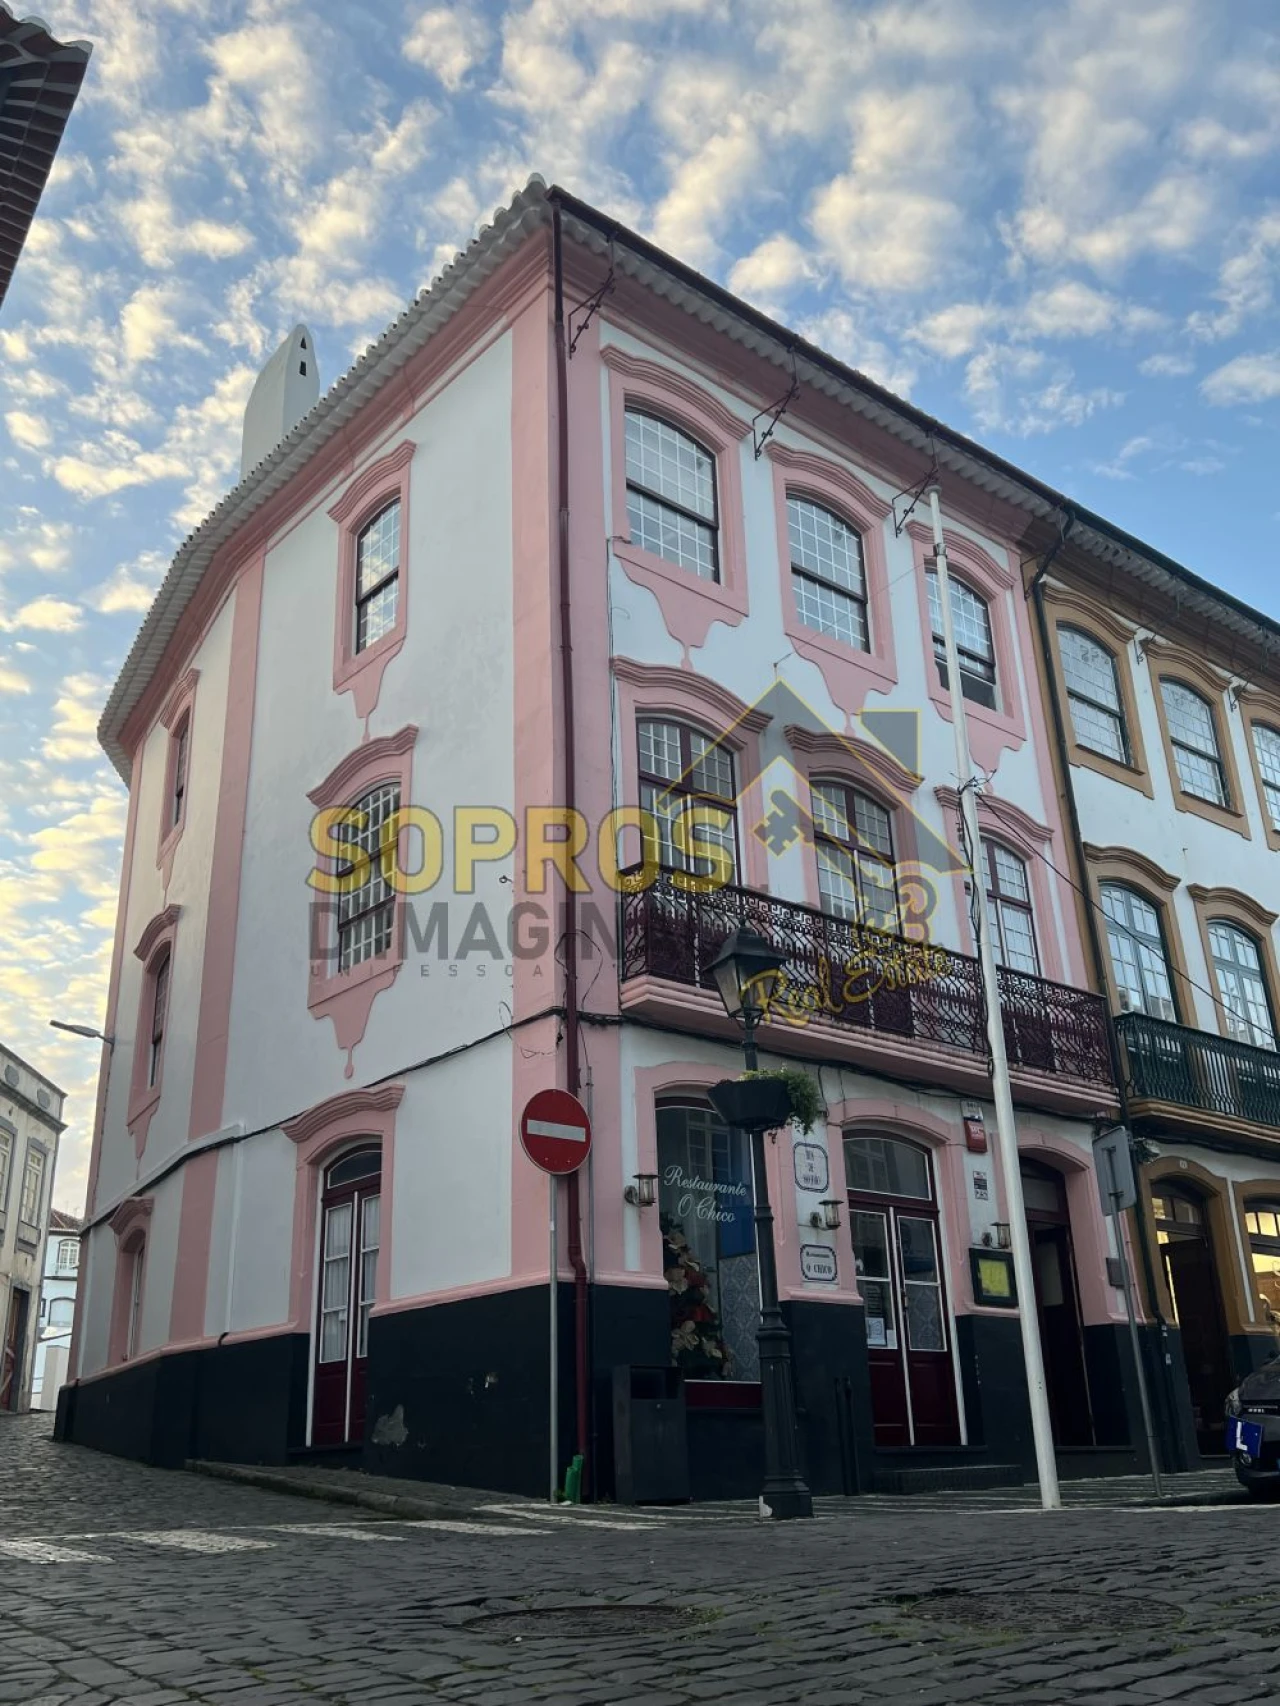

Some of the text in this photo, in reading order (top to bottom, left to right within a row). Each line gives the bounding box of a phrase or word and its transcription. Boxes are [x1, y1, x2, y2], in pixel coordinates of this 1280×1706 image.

[664, 1165, 747, 1196] Restaurante
[677, 1193, 736, 1223] O Chico
